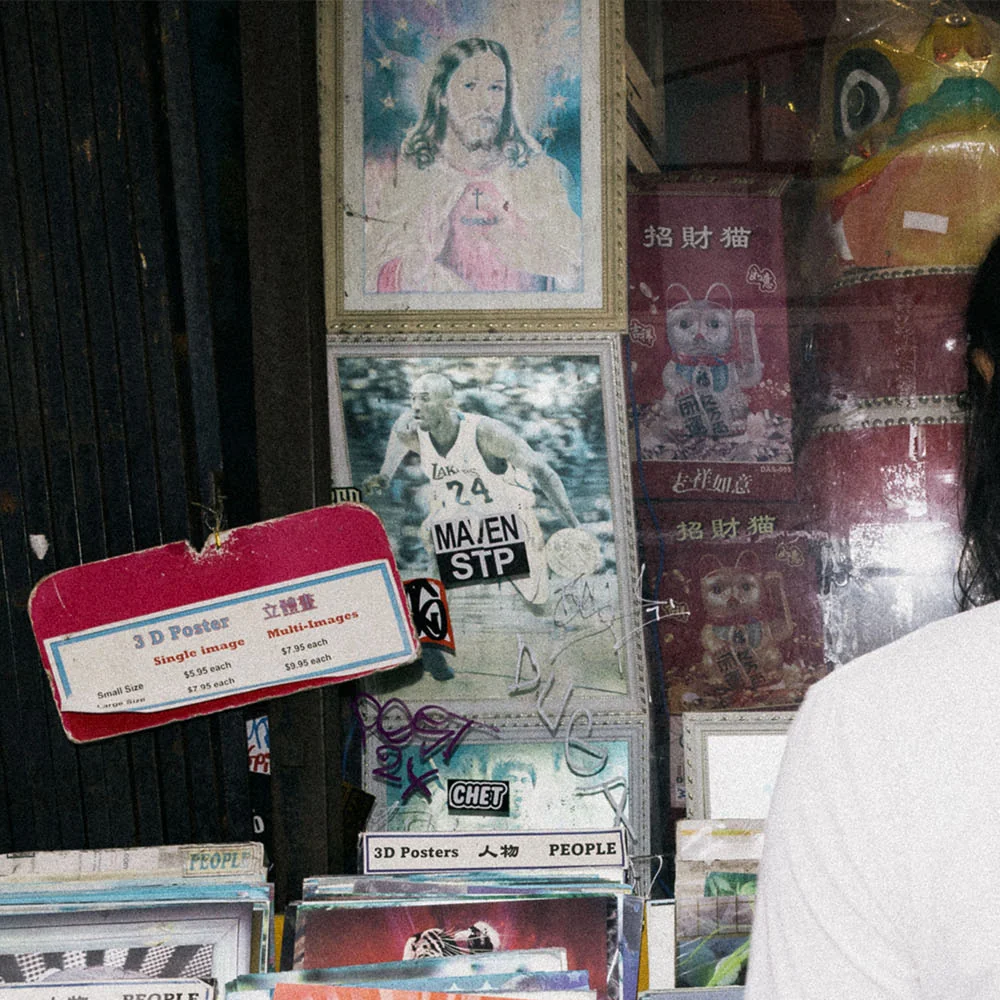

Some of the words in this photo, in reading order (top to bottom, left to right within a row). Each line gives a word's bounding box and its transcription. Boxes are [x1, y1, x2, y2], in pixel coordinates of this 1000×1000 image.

[642, 225, 752, 250] 招財猫
[450, 547, 515, 581] STP
[133, 633, 146, 650] 3
[149, 629, 165, 646] D
[168, 616, 230, 642] Poster
[266, 611, 360, 640] Multi-Images
[153, 649, 198, 667] Single
[200, 638, 246, 655] image
[281, 643, 306, 656] $7.95
[307, 638, 329, 650] each
[184, 667, 209, 680] $5.95
[210, 660, 232, 673] each
[285, 659, 309, 672] $9.95
[310, 653, 333, 666] each
[97, 687, 123, 700] Small
[125, 681, 145, 695] Size
[213, 676, 236, 689] each
[452, 784, 504, 807] CHET
[374, 847, 395, 860] 3D
[400, 846, 460, 860] Posters
[478, 843, 520, 860] 人物
[549, 842, 618, 857] PEOPLE
